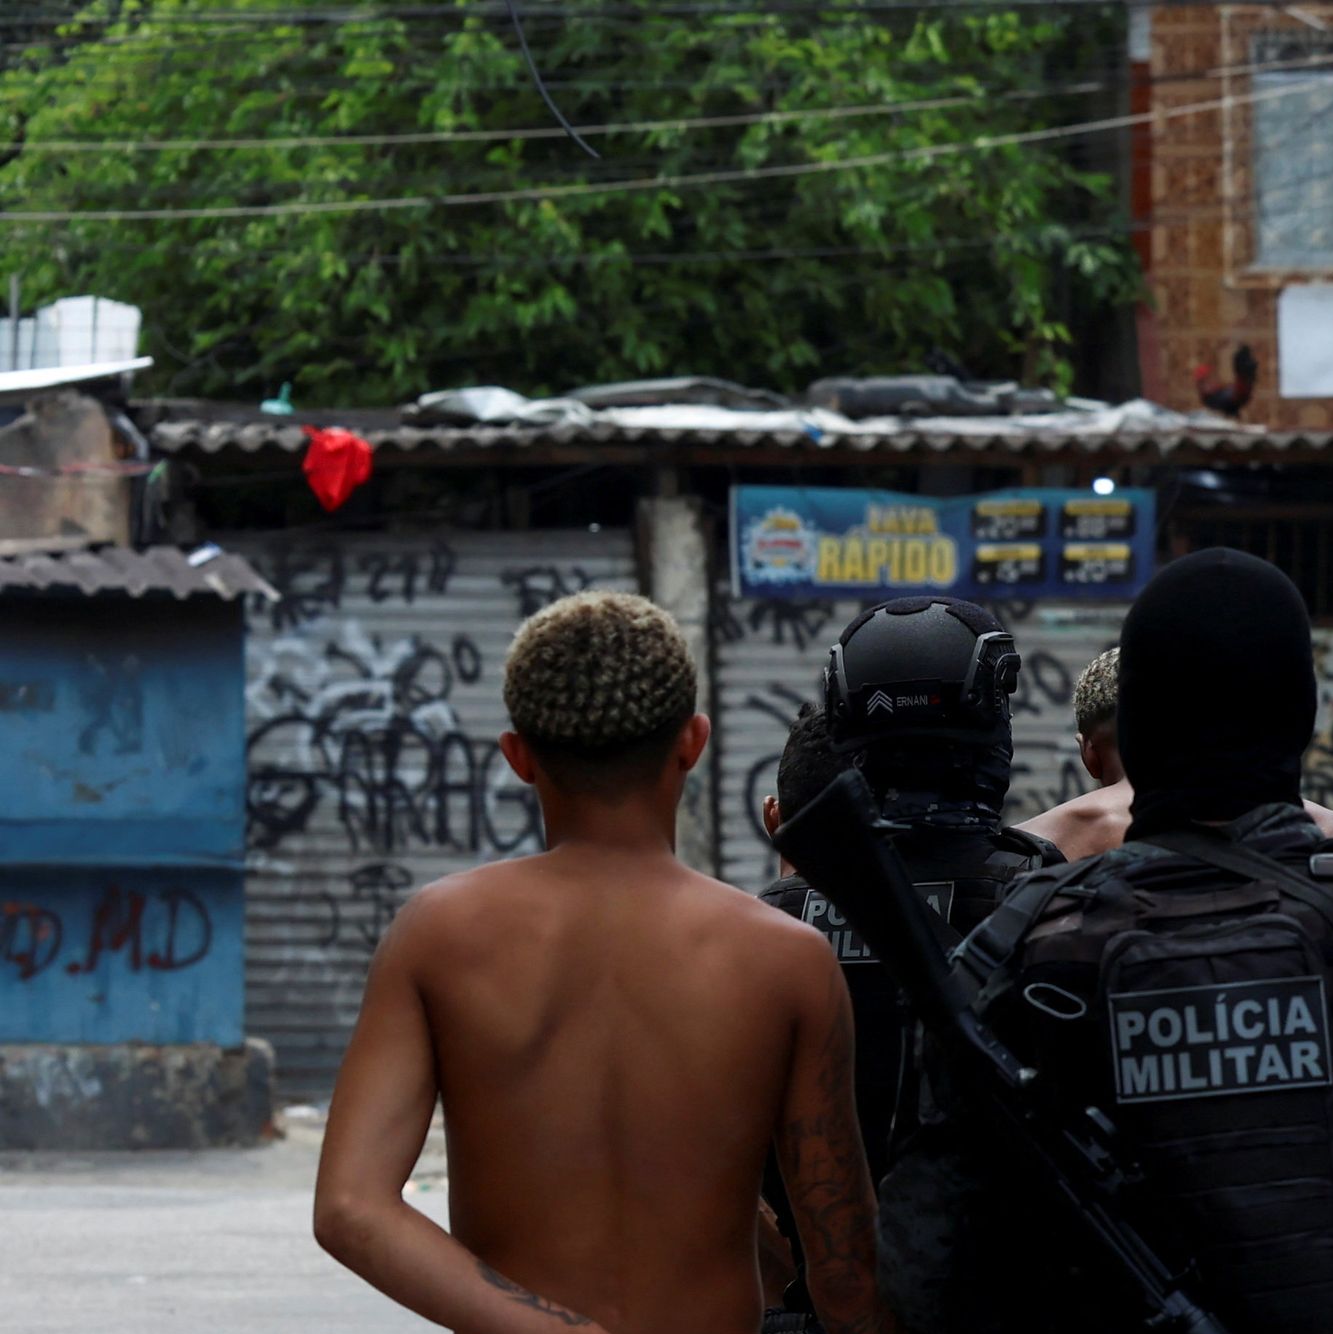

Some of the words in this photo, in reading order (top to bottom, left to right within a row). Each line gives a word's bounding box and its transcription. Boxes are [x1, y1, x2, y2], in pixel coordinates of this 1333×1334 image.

[896, 695, 928, 707] ERNANI
[1117, 993, 1317, 1050] POLÍCIA
[1121, 1040, 1324, 1094] MILITAR
